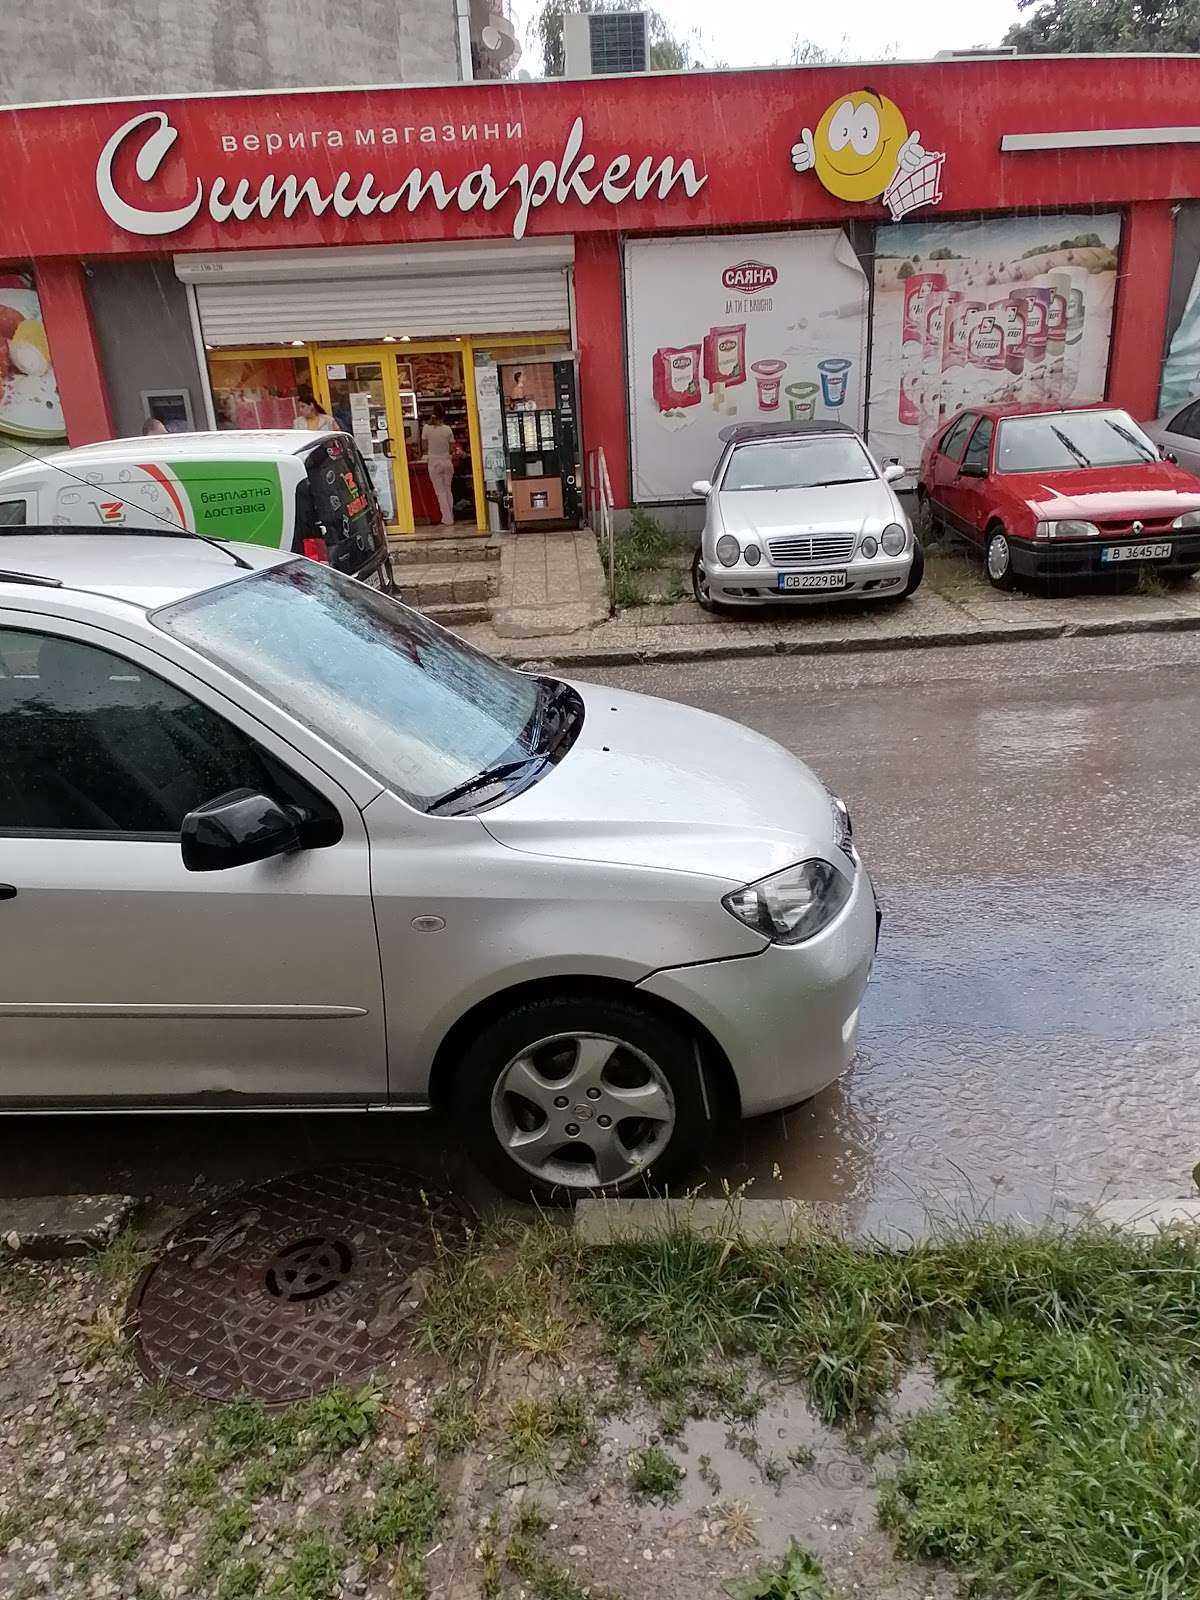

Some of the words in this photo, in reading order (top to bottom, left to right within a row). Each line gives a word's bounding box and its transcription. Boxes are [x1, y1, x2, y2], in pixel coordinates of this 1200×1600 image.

[222, 131, 343, 155] верига
[355, 122, 523, 146] магазини
[96, 110, 709, 241] Ситимаркет
[725, 268, 774, 286] САЯНА
[200, 487, 271, 504] безплатна
[1125, 546, 1153, 559] 3645
[802, 575, 828, 587] 2229
